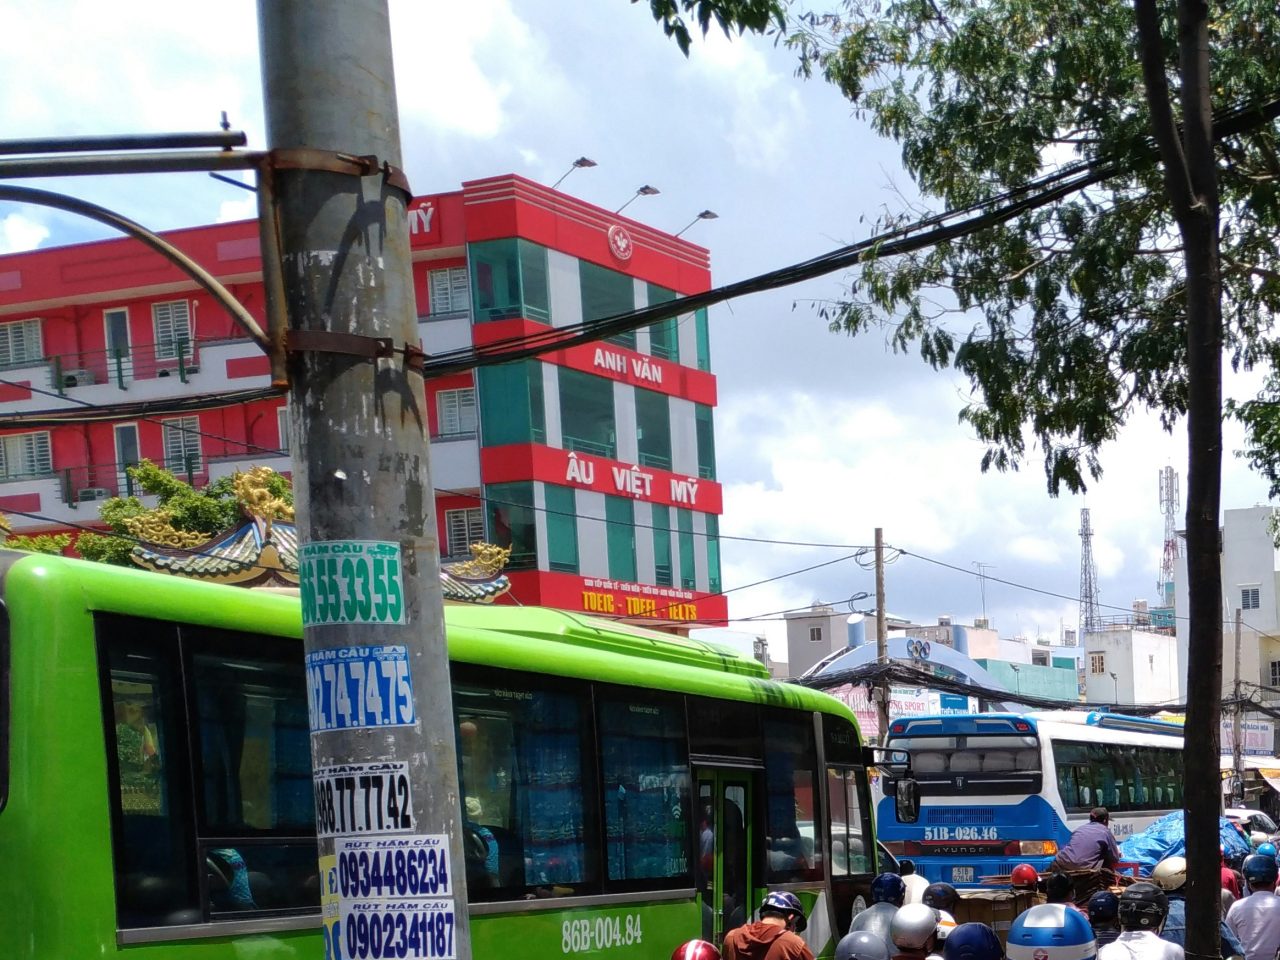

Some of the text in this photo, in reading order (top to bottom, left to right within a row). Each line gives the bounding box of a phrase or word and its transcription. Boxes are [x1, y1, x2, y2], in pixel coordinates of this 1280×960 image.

[593, 348, 663, 384] ANH VĂN
[566, 451, 699, 505] ÂU VIỆT MỸ
[582, 591, 615, 613] TOEIC
[626, 596, 658, 618] TOEFL
[668, 602, 697, 621] IELTS
[924, 826, 998, 841] 51B-026.46
[339, 848, 448, 898] 0934486234
[347, 912, 454, 959] 0902341187
[562, 914, 643, 954] 86B-004.84
